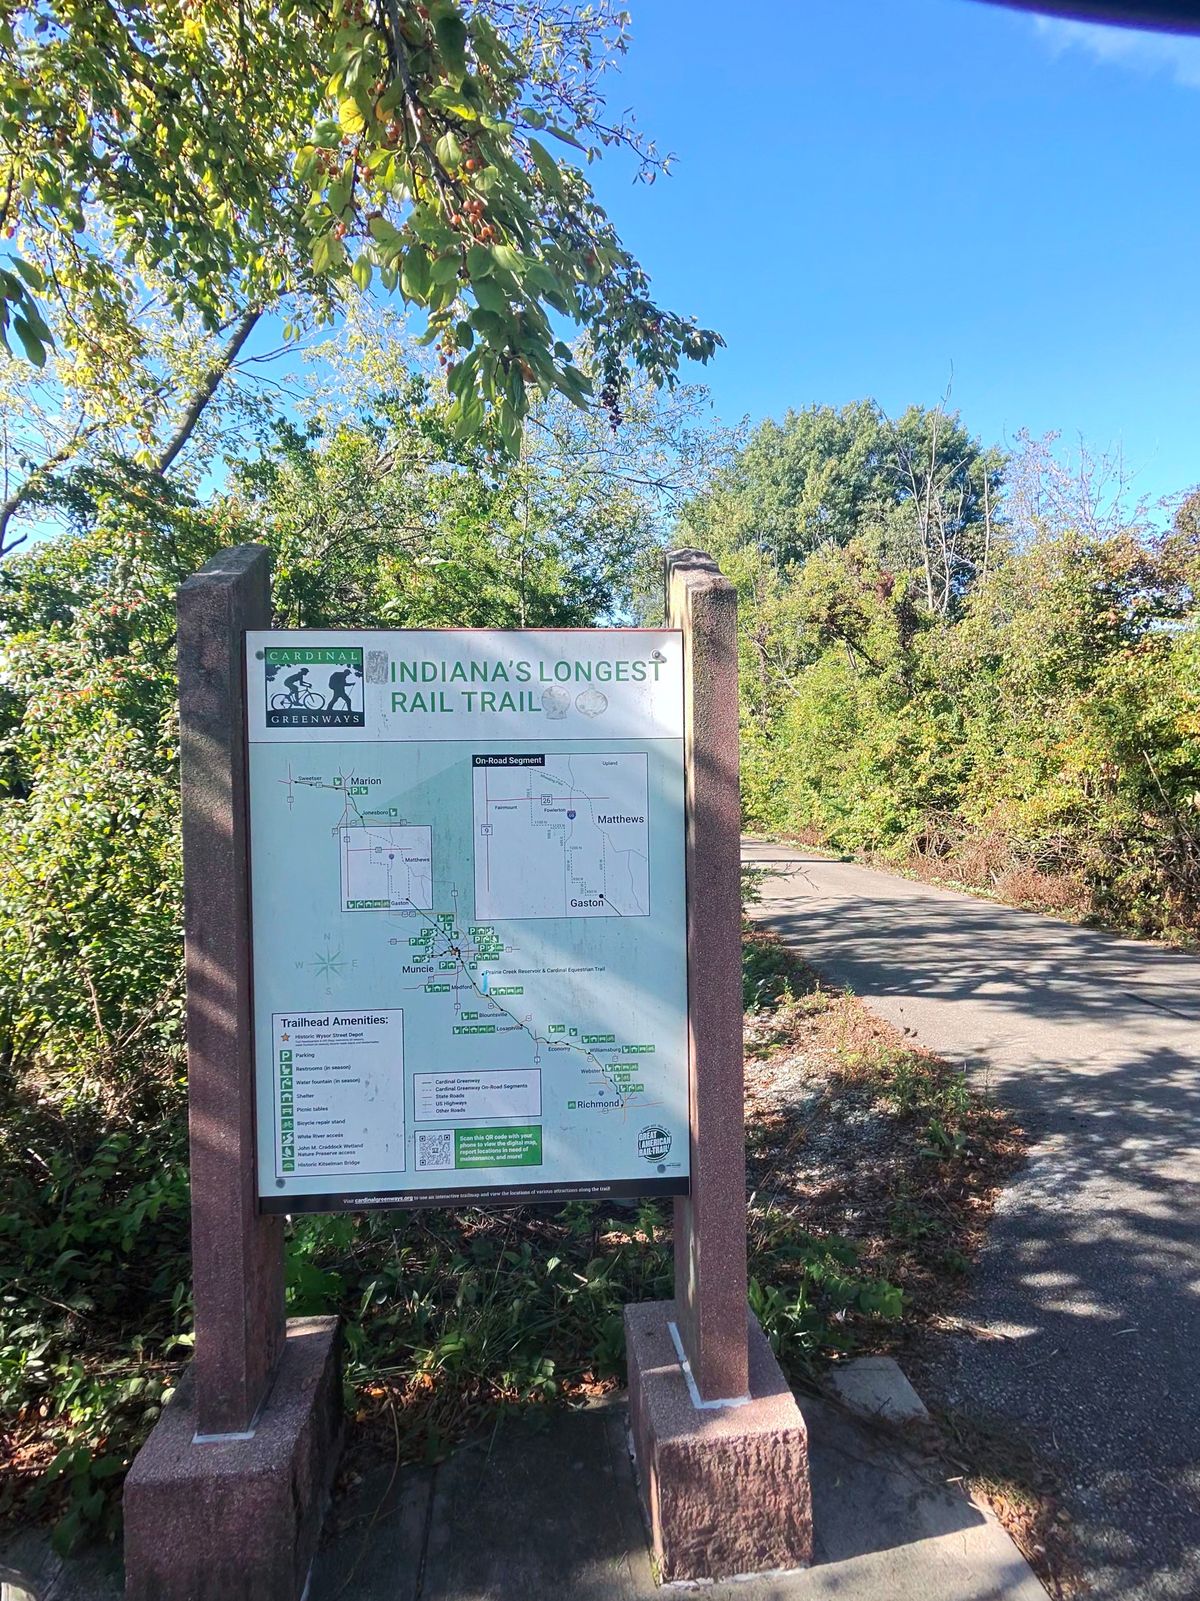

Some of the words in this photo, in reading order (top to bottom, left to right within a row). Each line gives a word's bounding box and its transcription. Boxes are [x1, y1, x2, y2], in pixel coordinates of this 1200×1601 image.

[269, 651, 358, 661] CARDINAL
[391, 660, 531, 683] INDIANA'S
[539, 660, 661, 682] LONGEST
[391, 691, 454, 713] RAIL
[461, 691, 542, 713] TRAIL
[271, 715, 360, 724] GREENWAYS
[509, 757, 542, 766] Segment
[351, 777, 382, 785] Marion
[597, 815, 645, 824] Matthews
[570, 899, 604, 908] Gaston
[323, 932, 331, 940] N
[295, 961, 304, 969] W
[351, 959, 358, 968] E
[402, 965, 434, 974] Muncie
[325, 987, 332, 996] S
[281, 1016, 330, 1028] Trailhead
[332, 1014, 389, 1026] Amenities:
[590, 1046, 621, 1054] Williamsburg
[282, 1051, 290, 1061] P
[577, 1099, 620, 1109] Richmond
[639, 1131, 657, 1140] GREAT
[641, 1137, 671, 1148] AMERICAN
[354, 1195, 414, 1204] cardinalgreenways.org
